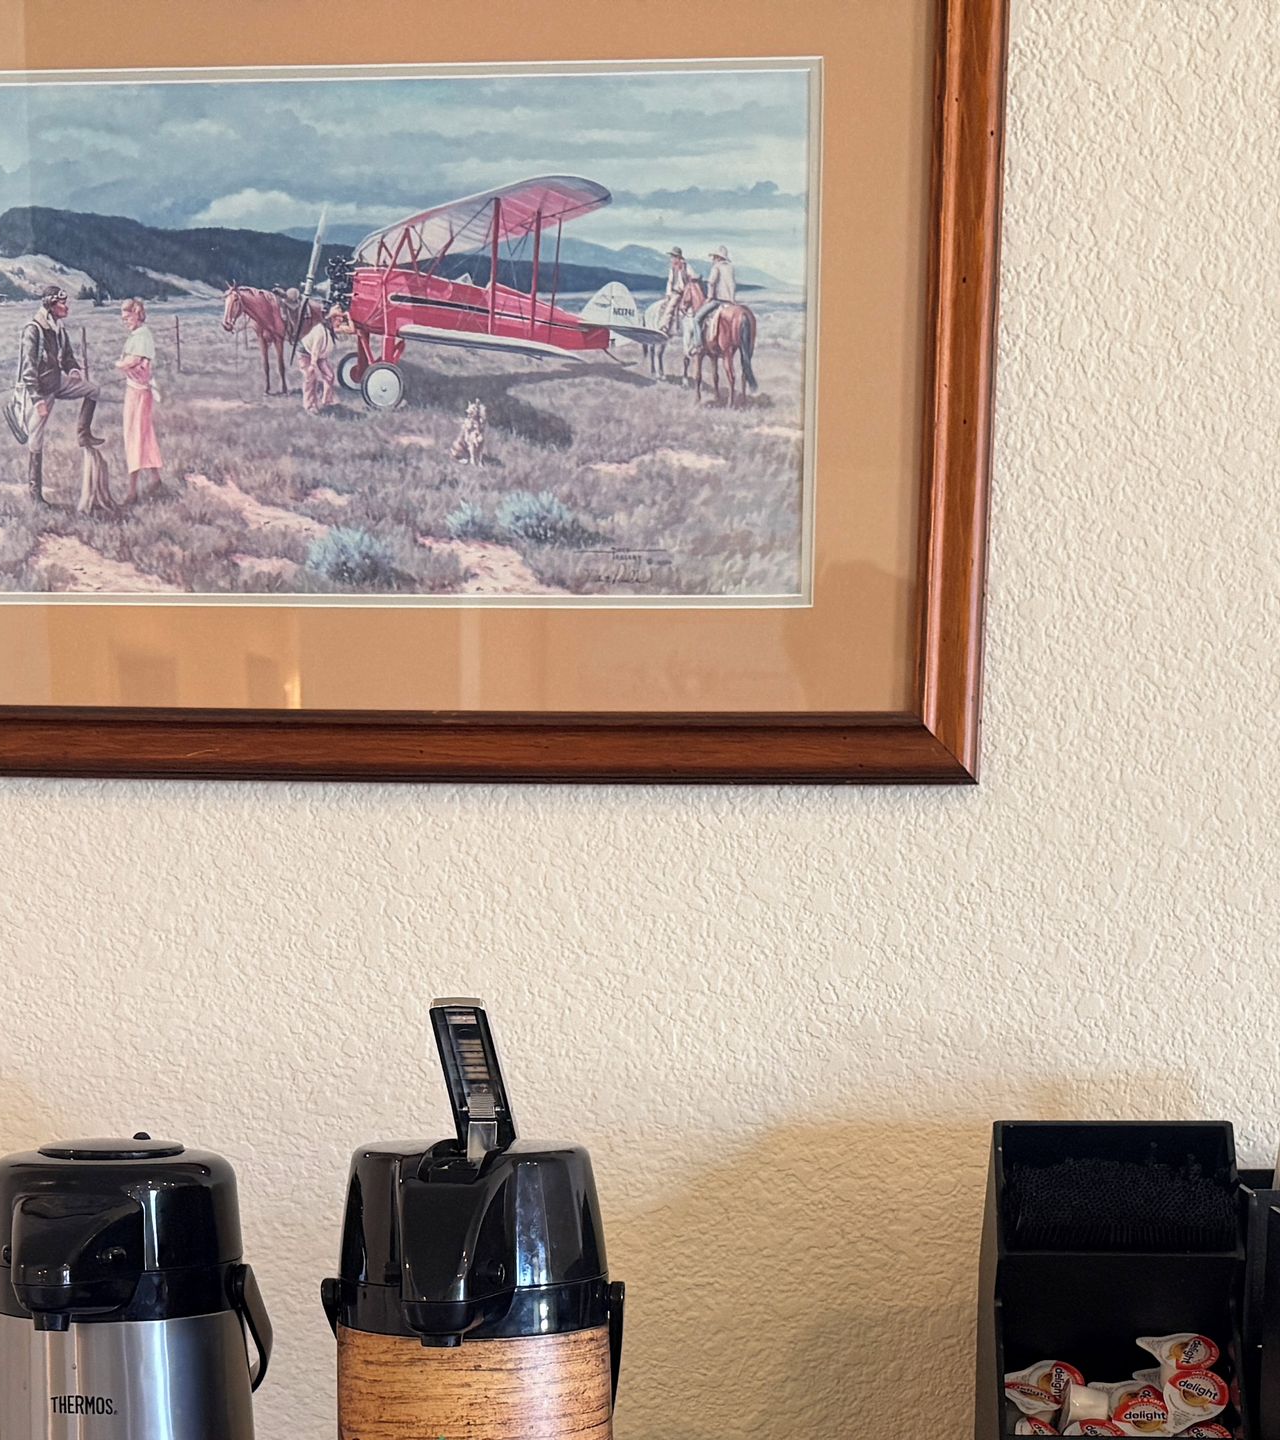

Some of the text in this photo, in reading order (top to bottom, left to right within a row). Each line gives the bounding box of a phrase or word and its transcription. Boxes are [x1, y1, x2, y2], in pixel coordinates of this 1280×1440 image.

[1181, 1339, 1202, 1364] delight
[1179, 1380, 1218, 1400] delight
[51, 1395, 114, 1416] THERMOS
[1124, 1411, 1167, 1421] delight
